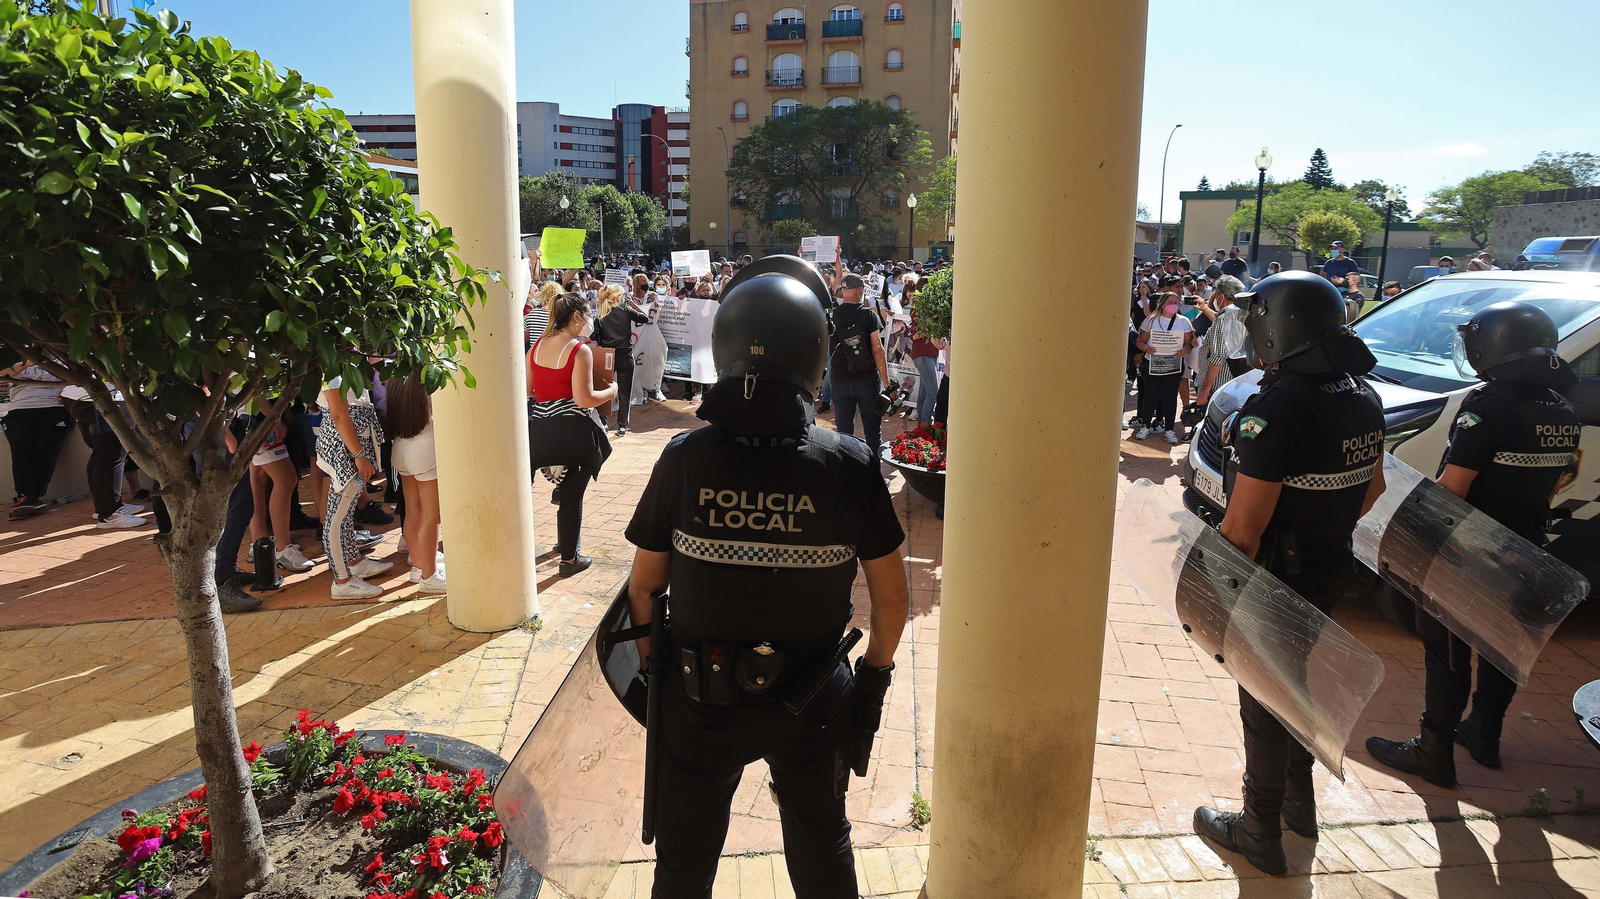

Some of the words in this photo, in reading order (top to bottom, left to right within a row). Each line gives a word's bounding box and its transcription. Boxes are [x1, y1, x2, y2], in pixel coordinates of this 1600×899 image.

[749, 345, 764, 355] 100
[1342, 429, 1384, 453] POLICIA
[1535, 425, 1580, 436] POLICIA
[1541, 436, 1575, 447] LOCAL
[1345, 444, 1379, 466] LOCAL
[1196, 473, 1212, 494] 5179
[698, 488, 816, 513] POLICIA
[709, 509, 803, 533] LOCAL
